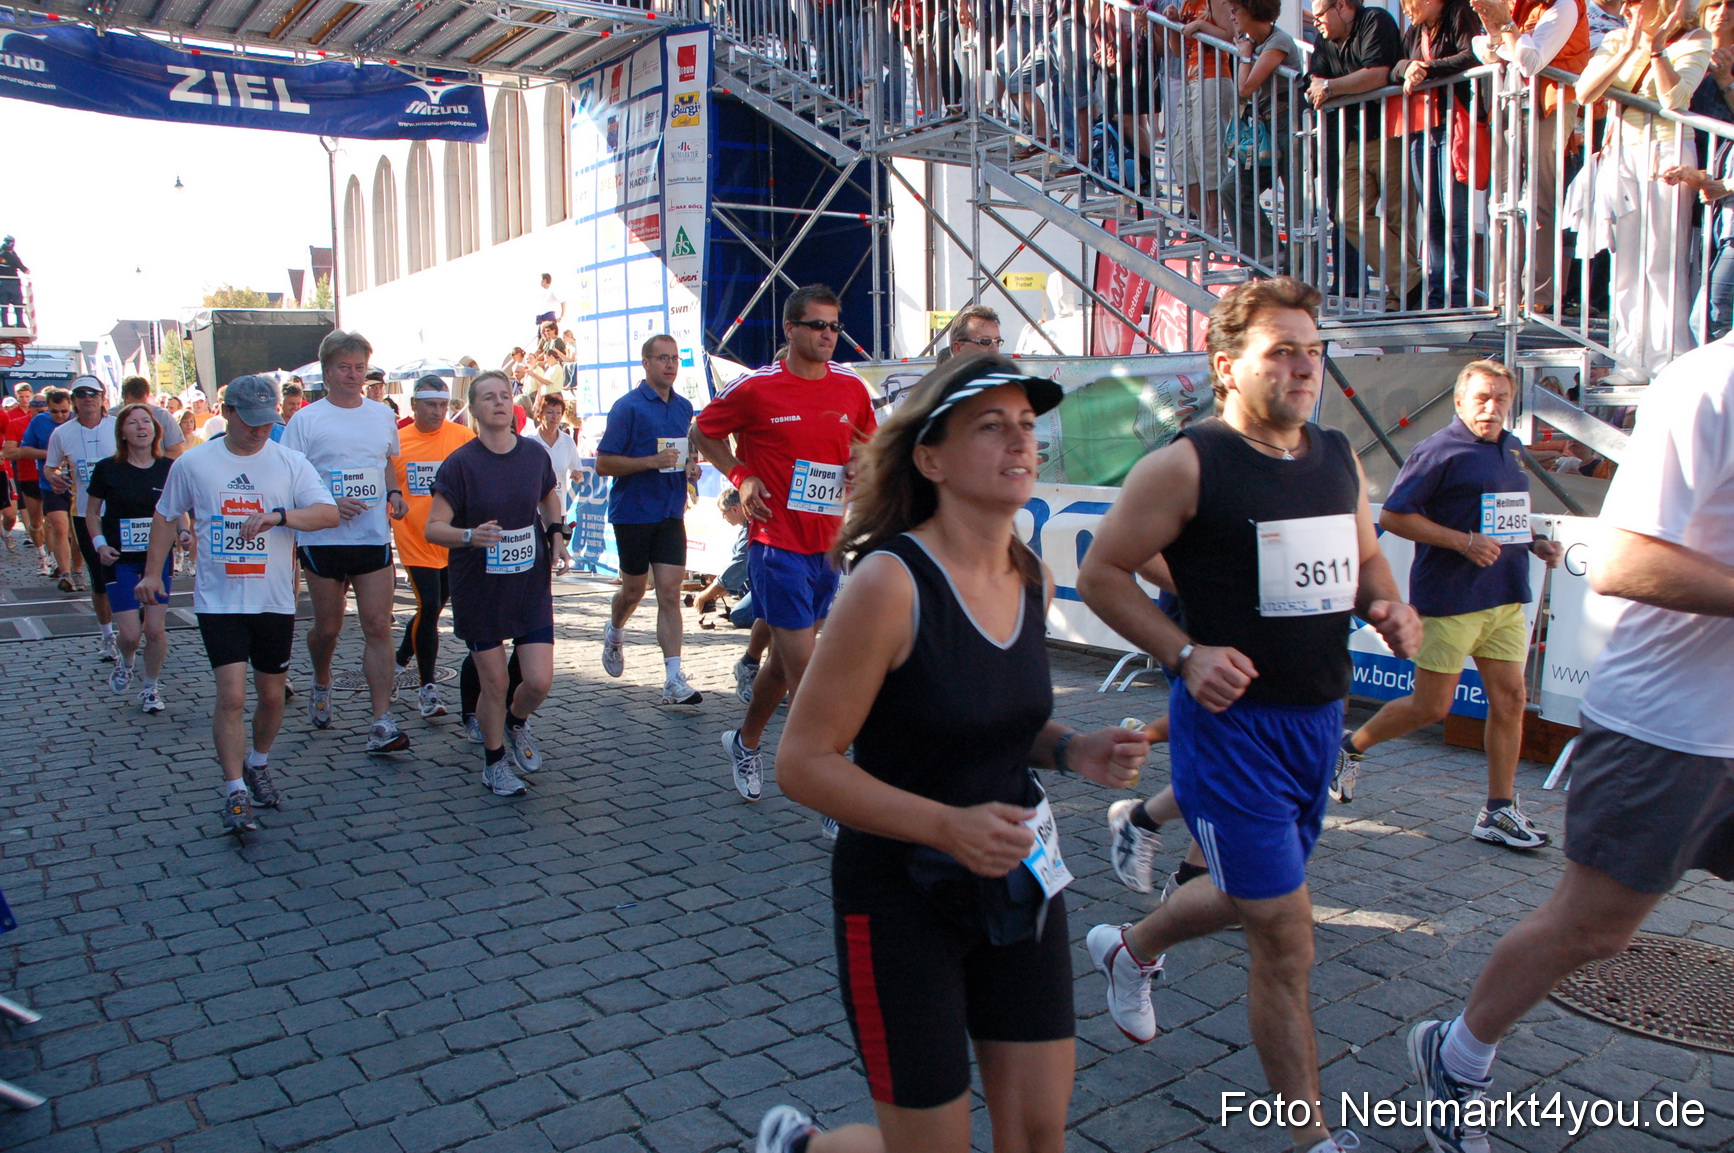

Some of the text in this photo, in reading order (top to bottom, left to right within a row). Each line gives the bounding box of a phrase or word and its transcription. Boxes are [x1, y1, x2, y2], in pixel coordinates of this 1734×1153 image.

[166, 65, 310, 114] ZIEL
[1127, 279, 1145, 319] Ostbaye
[770, 415, 802, 424] TOSHIBA
[343, 473, 364, 481] Bernd
[809, 467, 836, 480] Jürgen
[227, 483, 255, 491] adidas
[795, 478, 802, 487] D
[345, 484, 377, 498] 2960
[807, 484, 844, 502] 3014
[1485, 512, 1492, 521] D
[1497, 514, 1528, 530] 2486
[133, 532, 149, 543] 22
[214, 532, 221, 541] D
[501, 532, 531, 543] Michaela
[225, 536, 266, 551] 2958
[489, 546, 496, 554] D
[502, 545, 533, 562] 2959
[1295, 557, 1351, 588] 3611
[1552, 664, 1590, 685] ww
